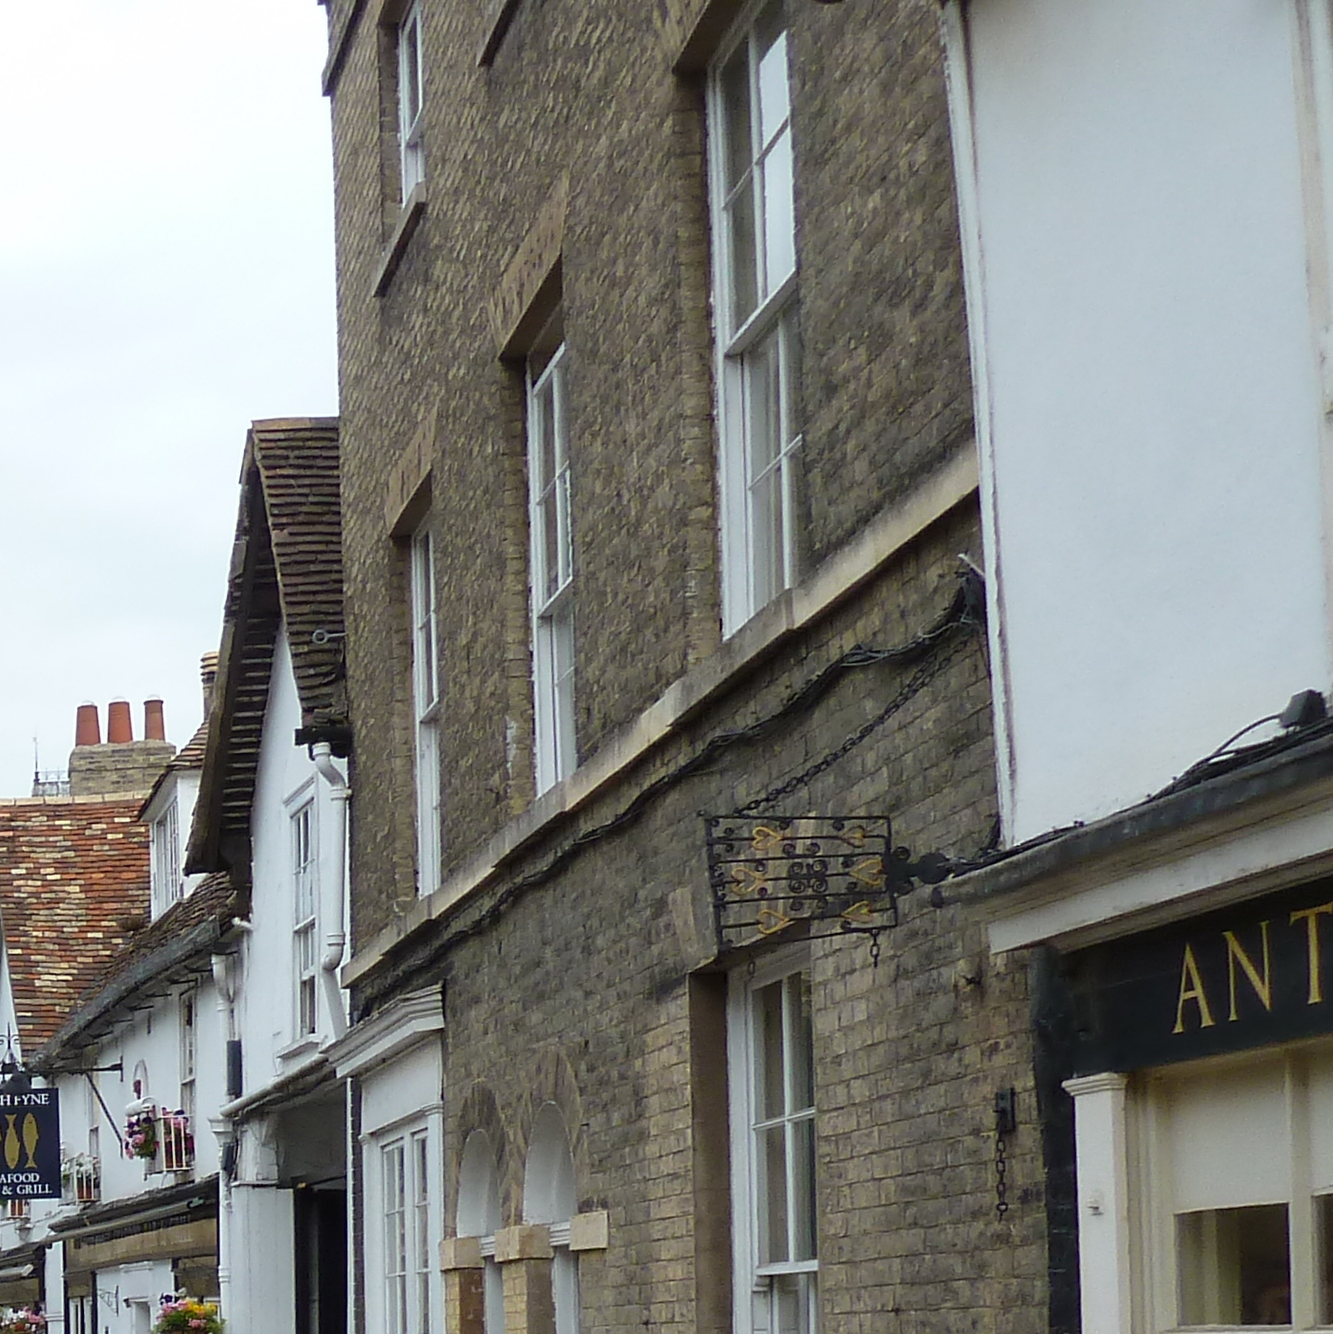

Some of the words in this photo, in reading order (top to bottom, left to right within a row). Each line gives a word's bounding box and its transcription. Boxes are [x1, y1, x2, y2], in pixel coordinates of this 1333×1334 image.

[1171, 901, 1333, 1034] ANT
[13, 1093, 50, 1106] FYNE
[1, 1185, 13, 1195] &
[16, 1183, 53, 1194] GRILL
